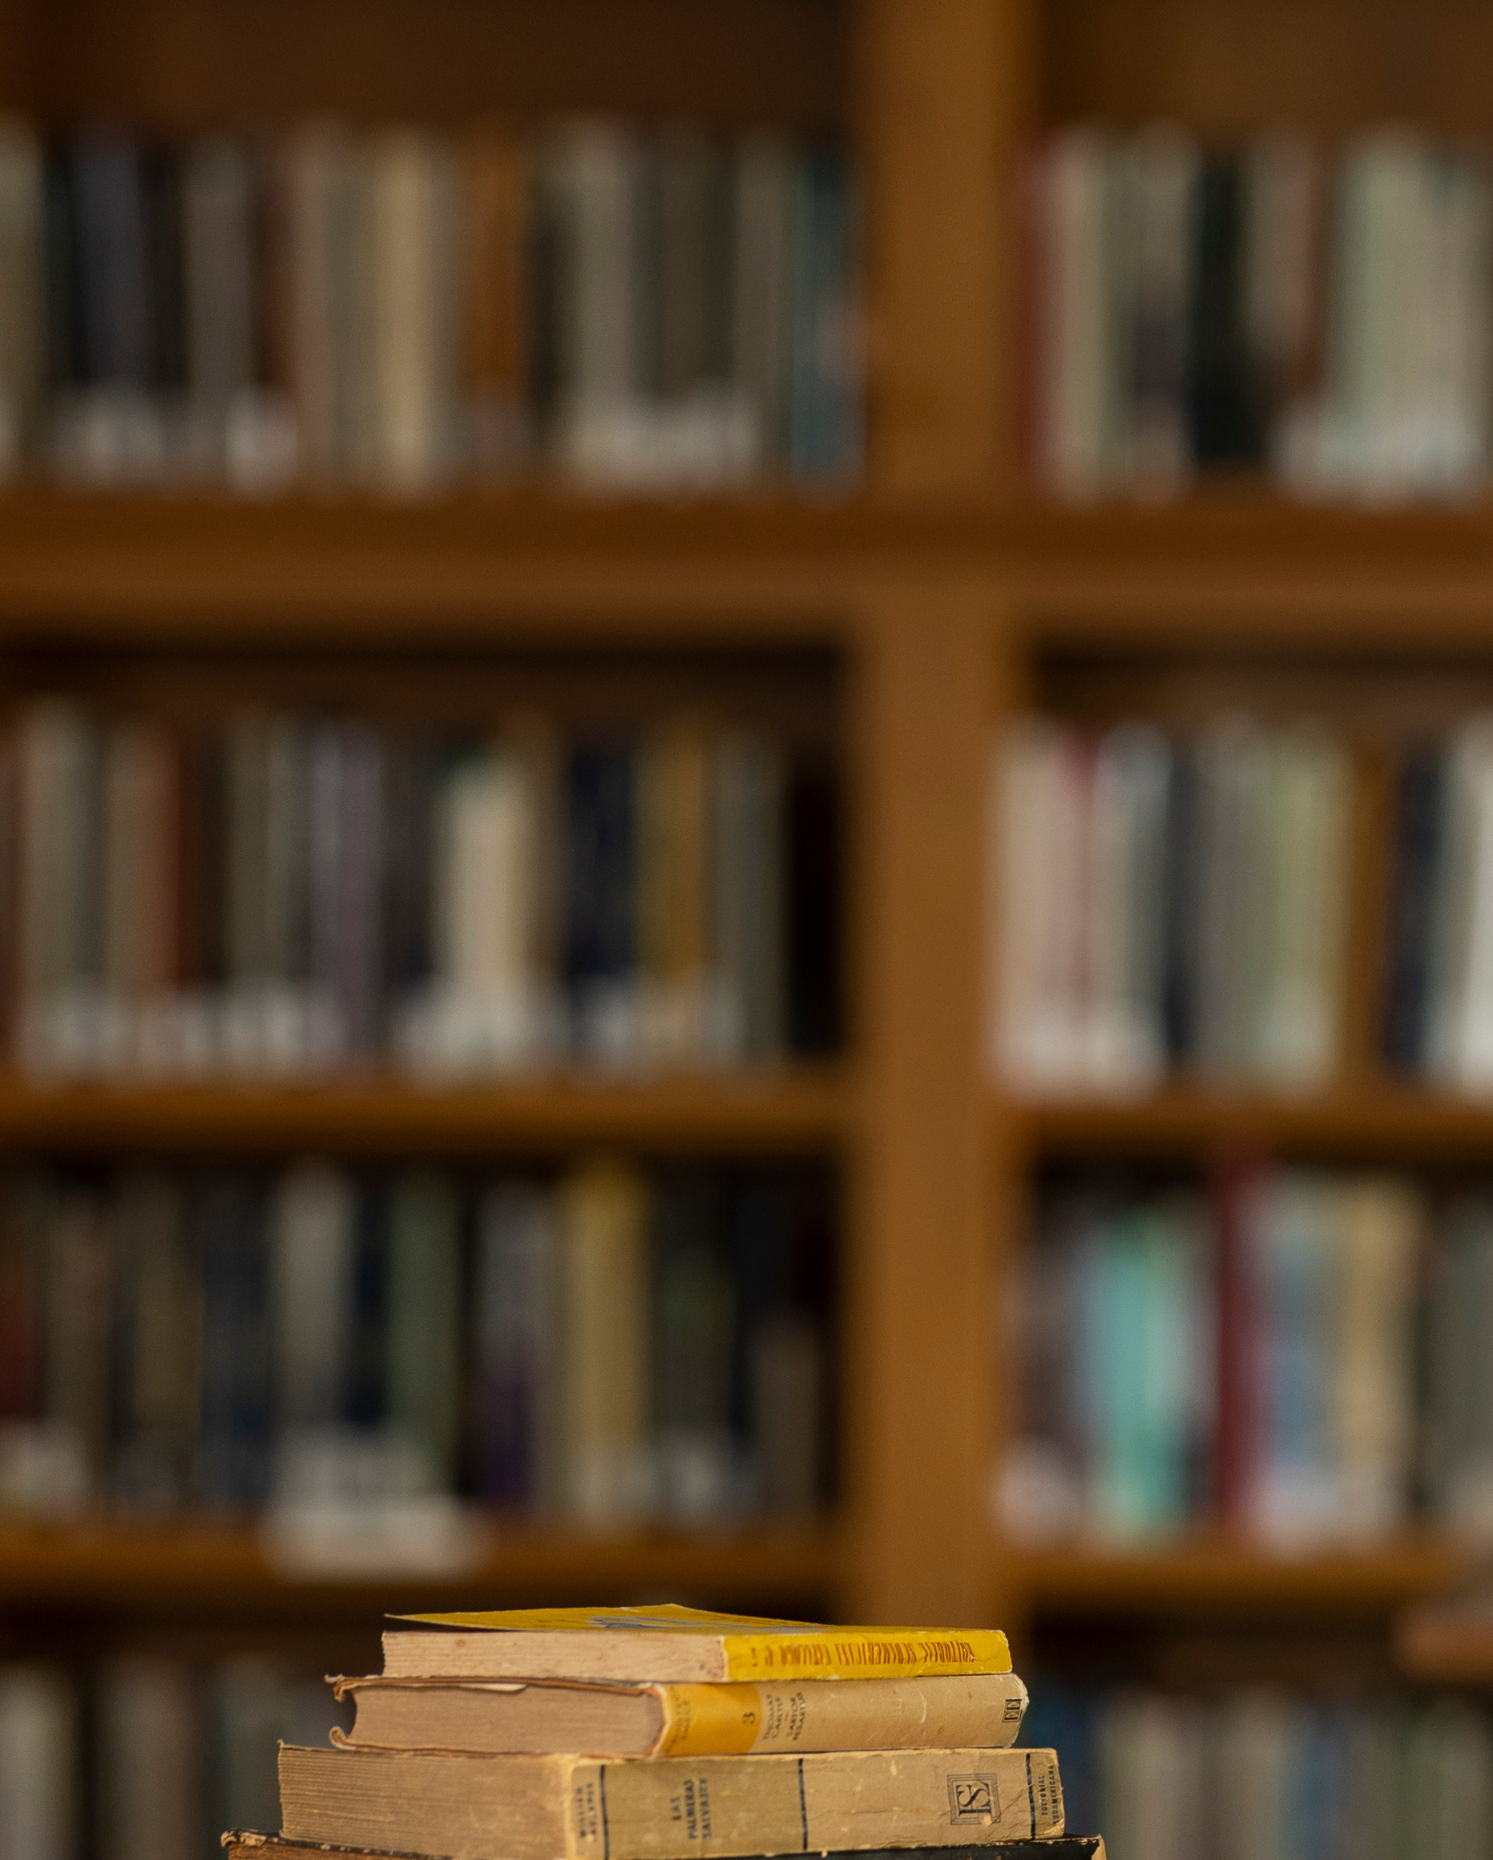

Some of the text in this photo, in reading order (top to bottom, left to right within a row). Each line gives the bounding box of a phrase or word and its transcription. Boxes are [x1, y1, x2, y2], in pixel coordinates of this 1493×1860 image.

[742, 1711, 756, 1725] 3
[683, 1778, 698, 1840] PALMERAS
[1037, 1775, 1049, 1816] EDITORIAL
